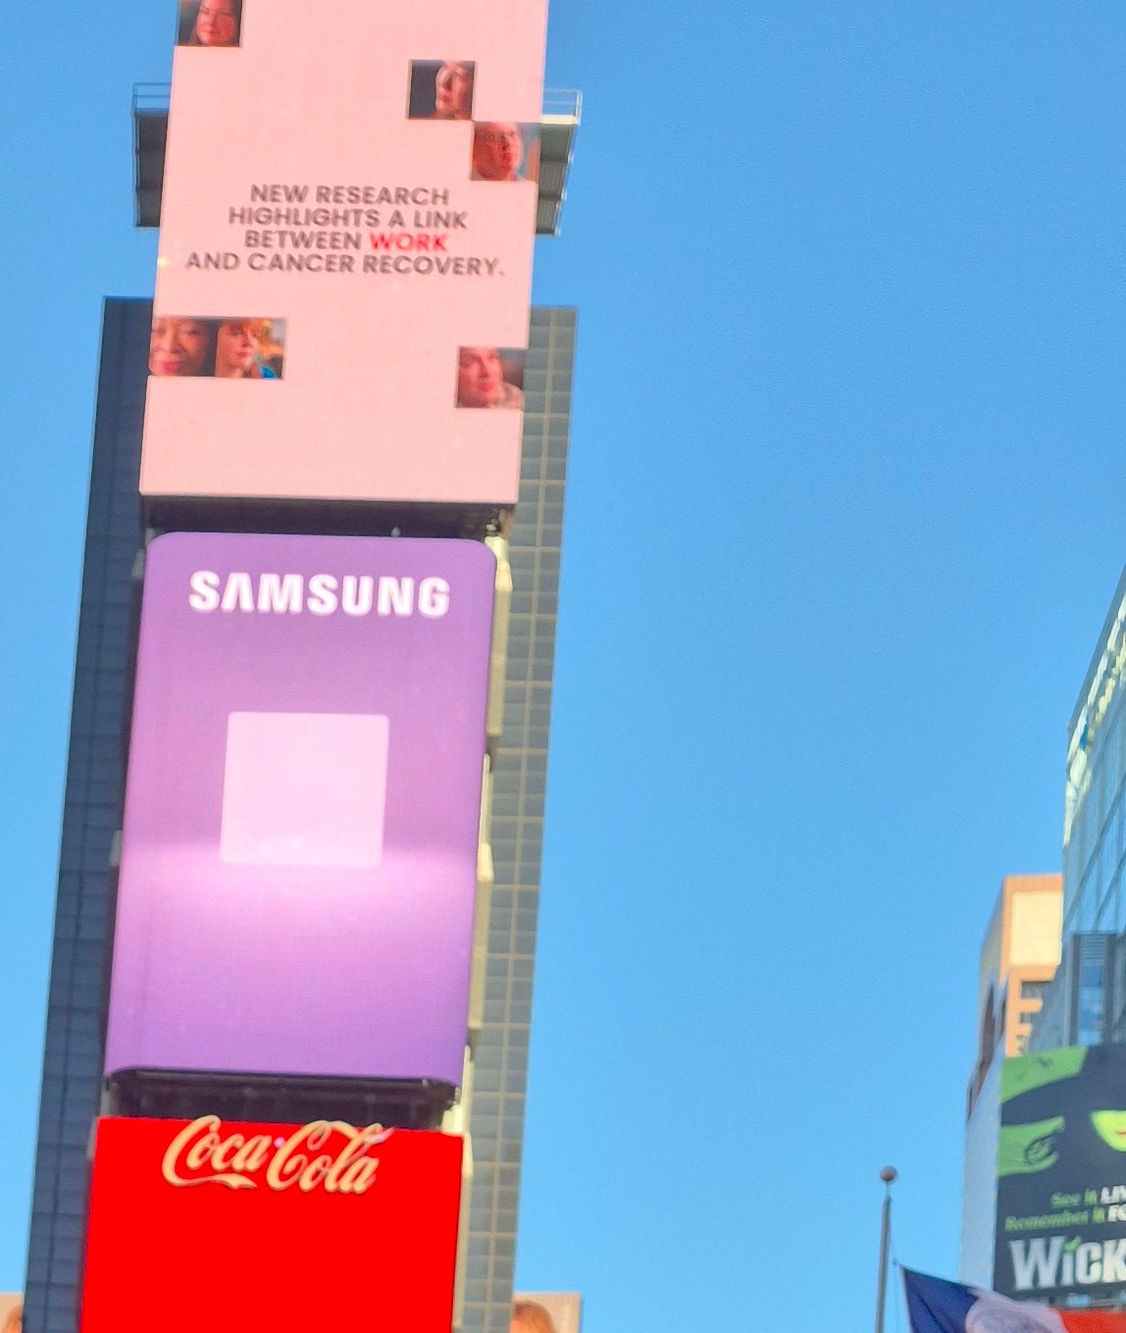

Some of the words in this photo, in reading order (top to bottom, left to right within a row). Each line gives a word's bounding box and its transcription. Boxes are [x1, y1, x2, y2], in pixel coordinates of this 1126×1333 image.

[250, 184, 309, 203] NEW
[315, 186, 450, 206] RESEARCH
[228, 206, 381, 227] HIGHLIGHTS
[388, 209, 407, 228] A
[413, 211, 469, 230] LINK
[244, 229, 363, 250] BETWEEN
[368, 232, 449, 252] WORK
[184, 252, 241, 272] AND
[246, 253, 356, 274] CANCER
[362, 254, 506, 277] RECOVERY.
[188, 570, 451, 620] SAMSUNG
